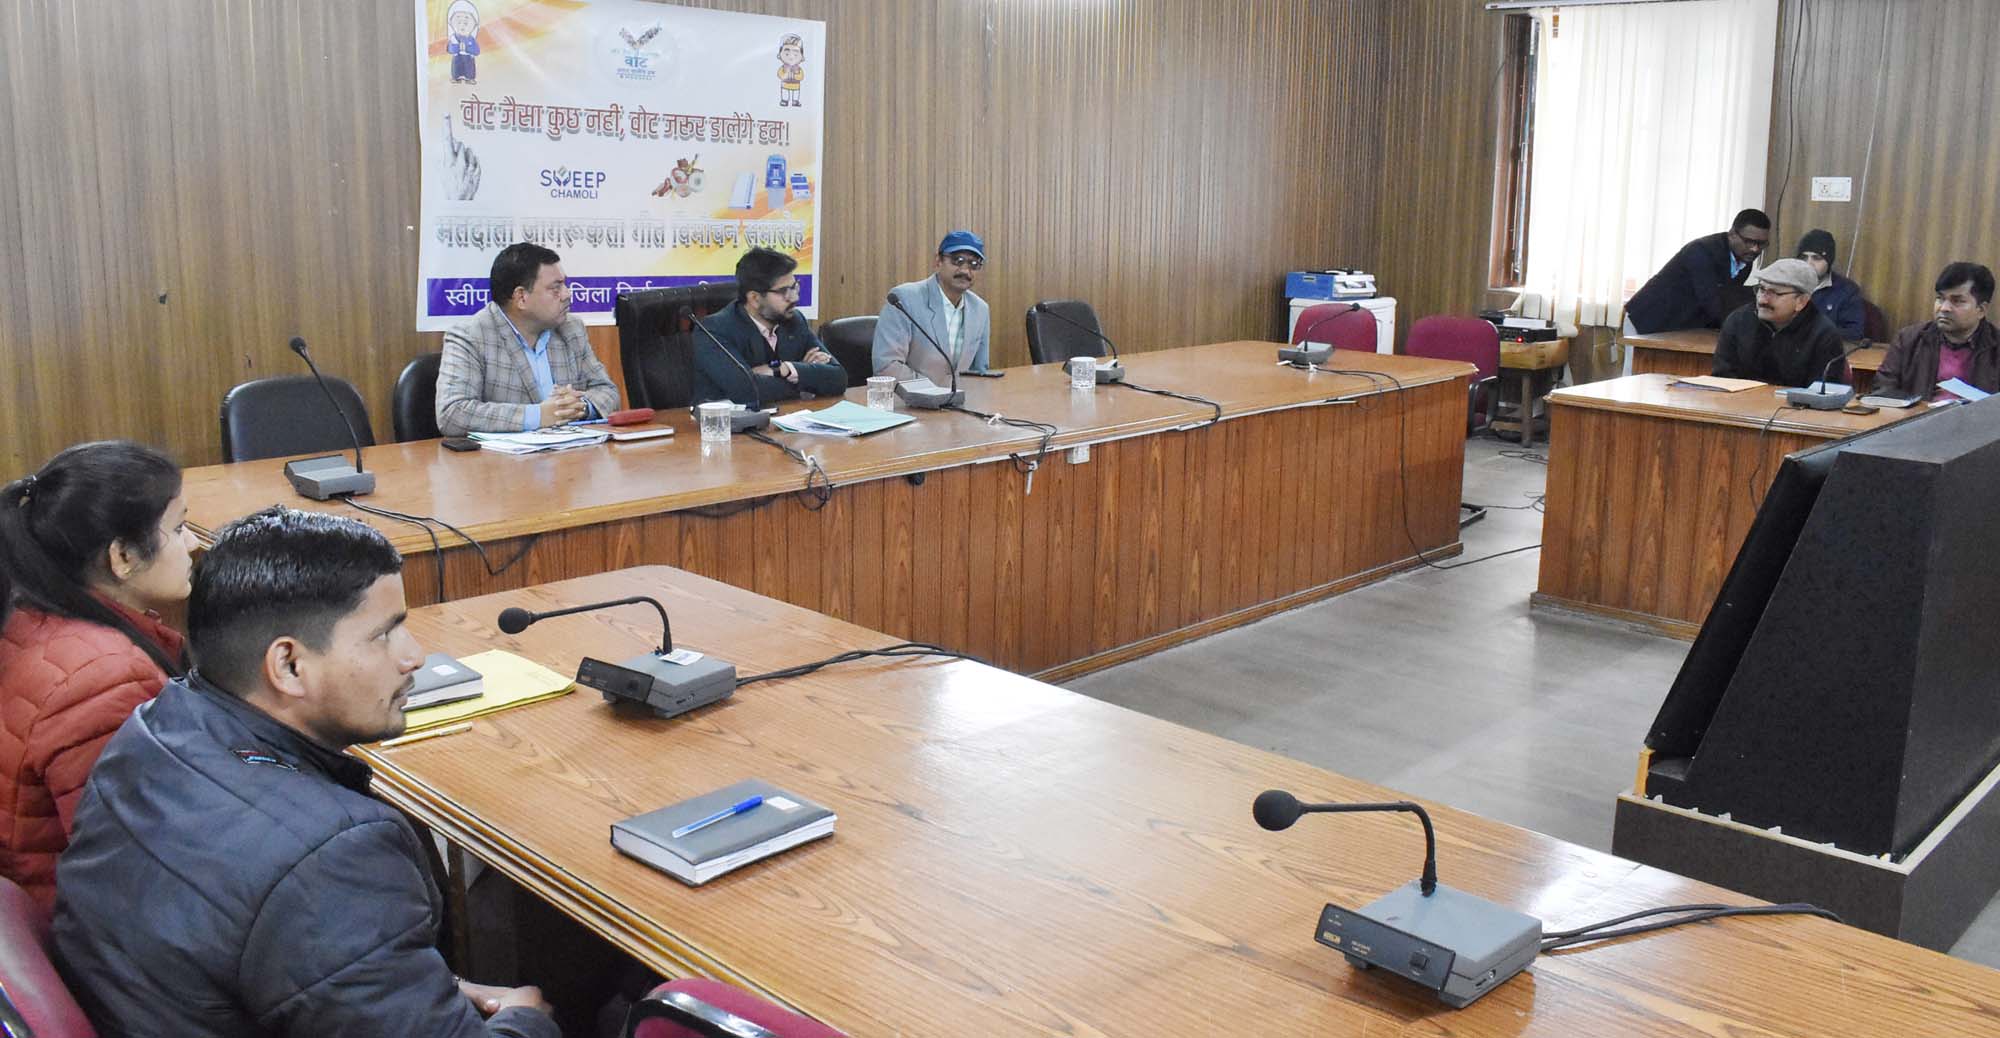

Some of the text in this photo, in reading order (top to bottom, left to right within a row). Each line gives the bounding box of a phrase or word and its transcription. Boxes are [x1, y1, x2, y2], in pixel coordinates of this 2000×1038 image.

[461, 94, 496, 129] वोट
[499, 96, 543, 132] जैसा
[547, 106, 582, 140] कुछ
[584, 103, 625, 141] नहीं,
[629, 105, 659, 139] वोट
[663, 113, 706, 141] जरूर
[540, 168, 606, 188] SWEEP
[550, 188, 598, 199] CHAMOLI
[444, 283, 490, 306] स्वीप
[570, 282, 611, 304] जिला
